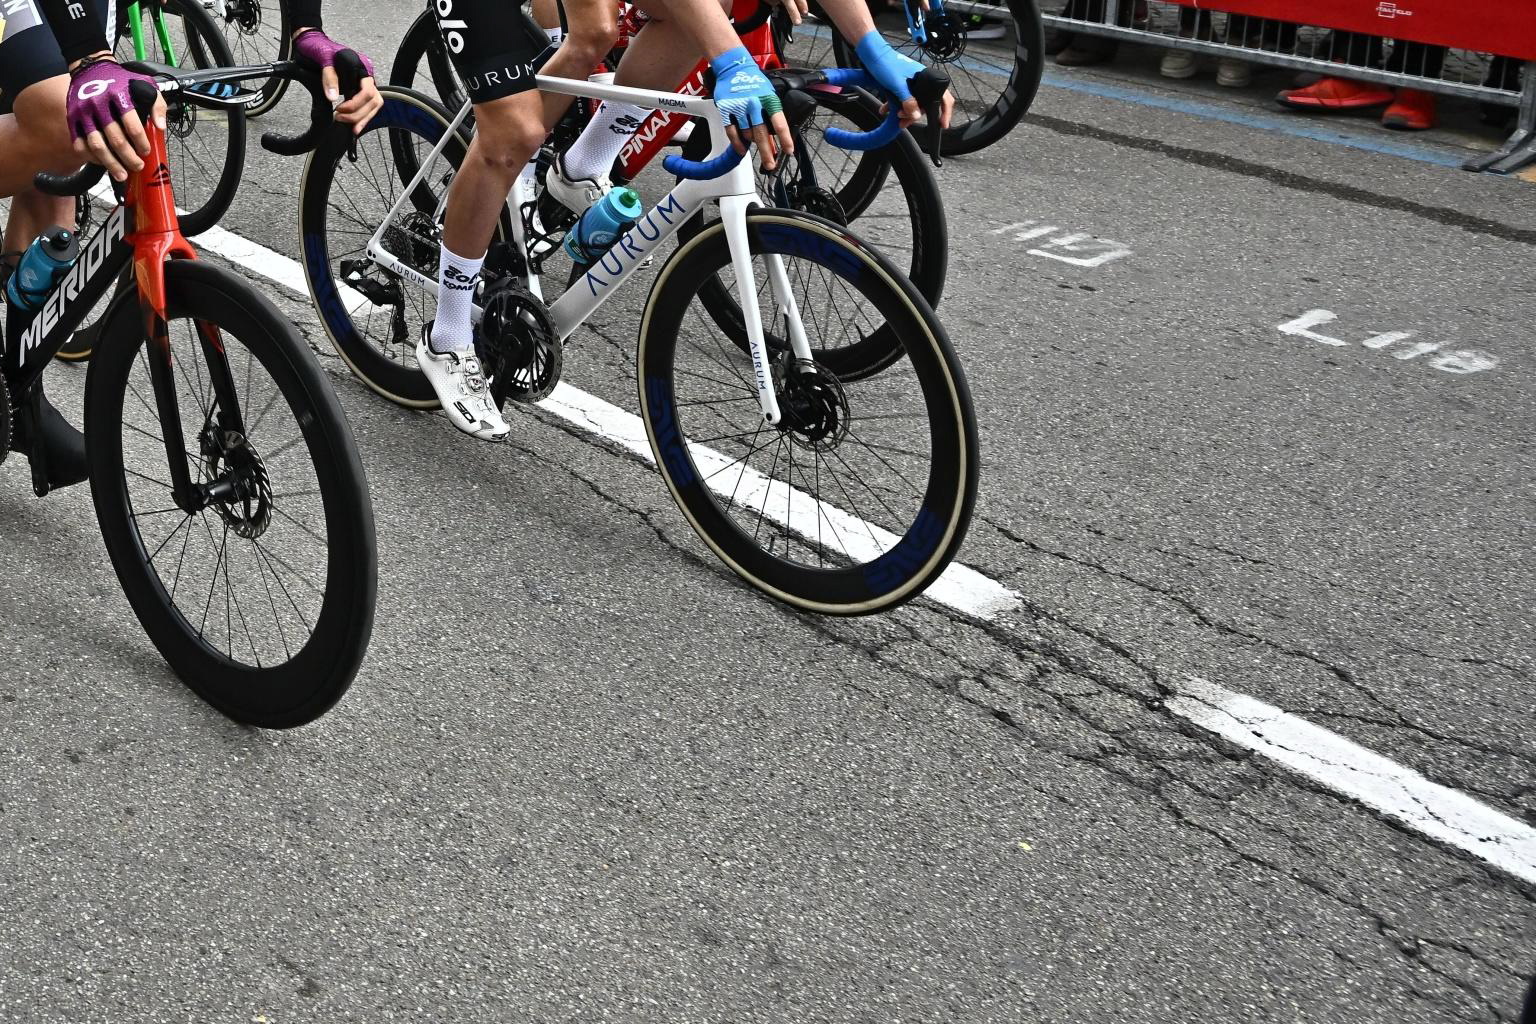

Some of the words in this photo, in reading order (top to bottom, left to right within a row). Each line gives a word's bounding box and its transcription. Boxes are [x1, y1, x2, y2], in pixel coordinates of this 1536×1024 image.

[658, 97, 687, 109] MAGMA
[585, 193, 688, 297] AURUM
[18, 204, 126, 369] MERIDA
[389, 262, 426, 287] AURUM
[750, 341, 767, 391] AURUM
